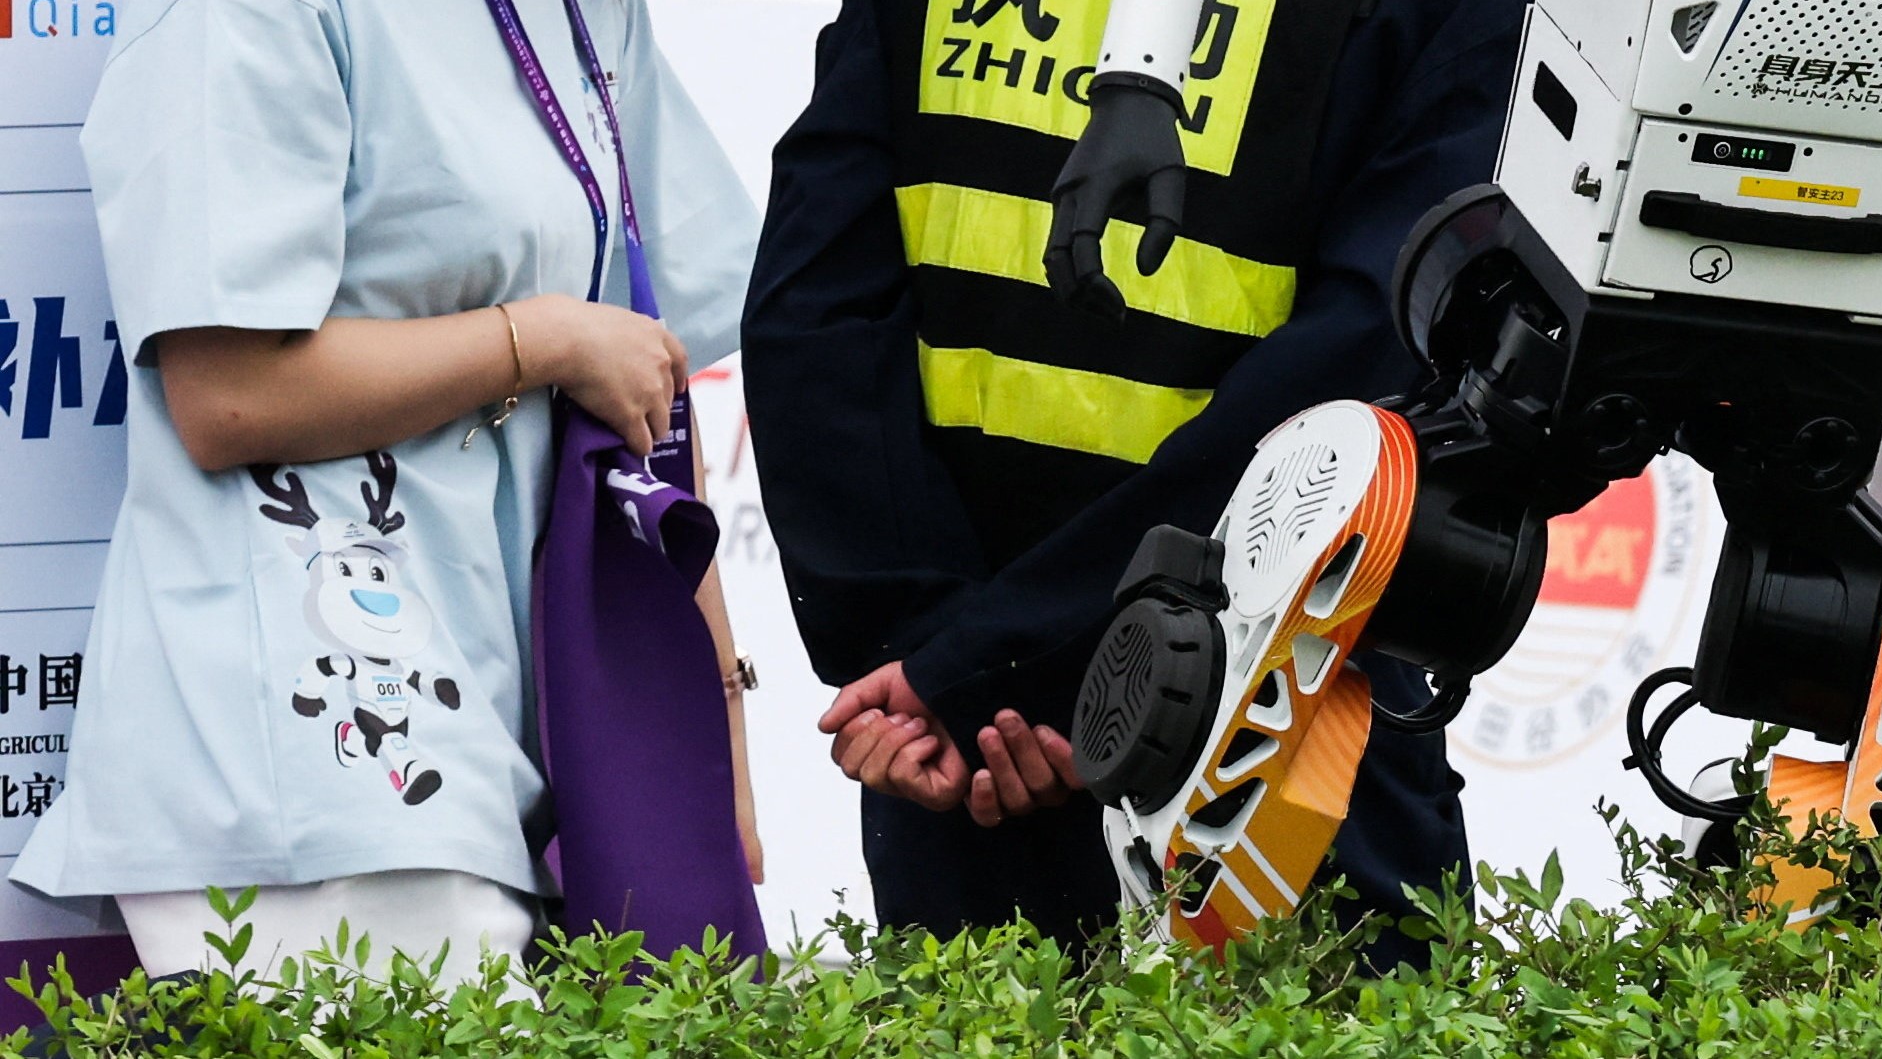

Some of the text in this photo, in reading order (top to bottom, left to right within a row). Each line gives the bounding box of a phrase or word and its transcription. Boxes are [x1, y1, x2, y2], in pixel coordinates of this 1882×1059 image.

[936, 37, 1213, 134] ZHIN
[376, 683, 402, 696] 001
[0, 772, 64, 819] 北京
